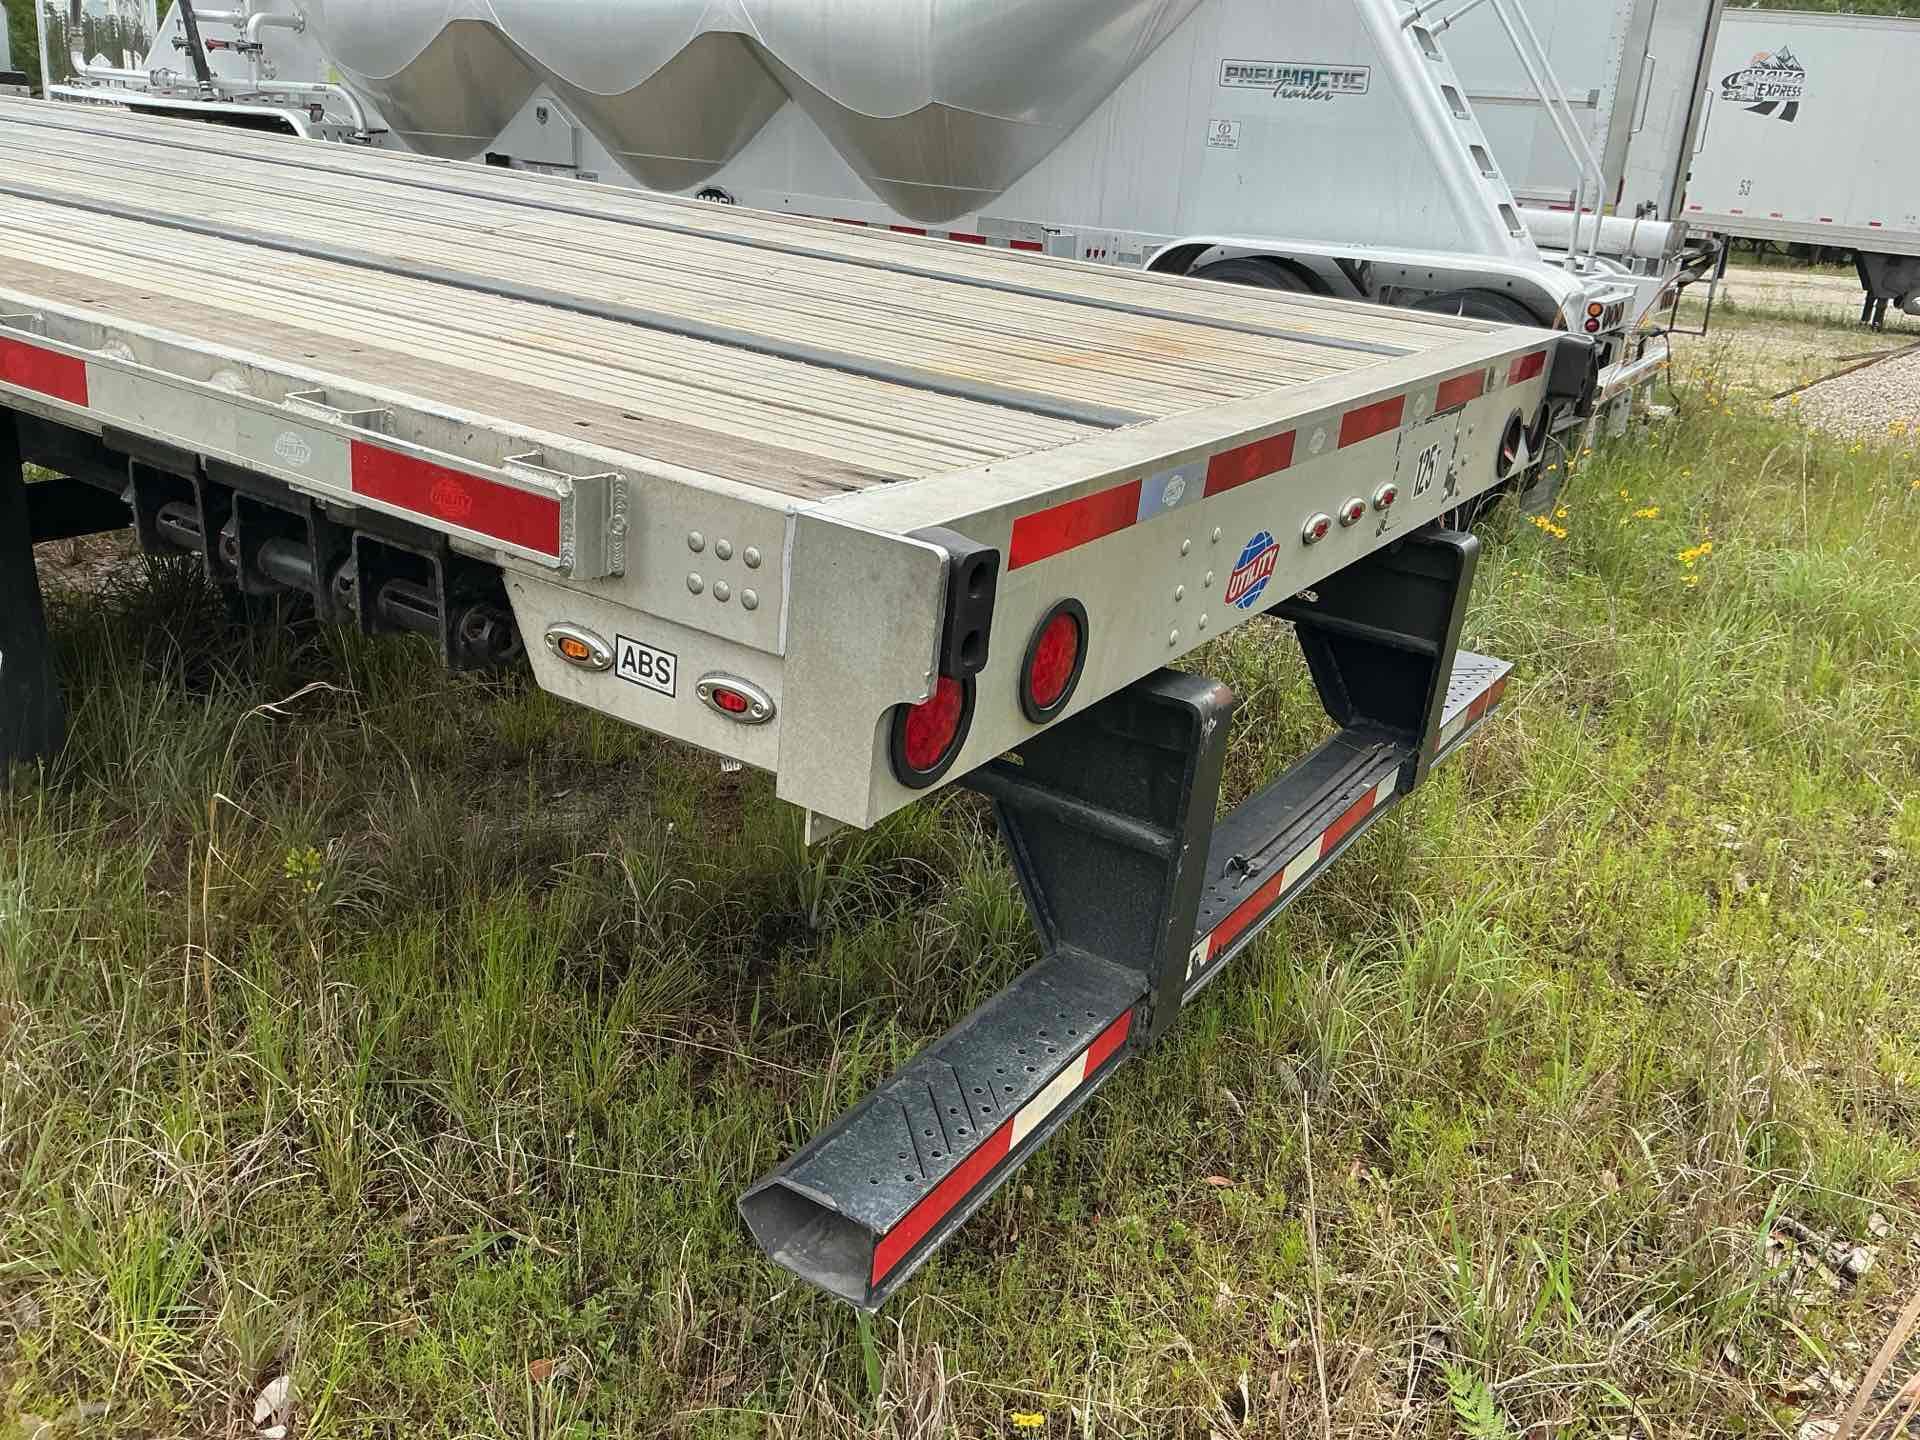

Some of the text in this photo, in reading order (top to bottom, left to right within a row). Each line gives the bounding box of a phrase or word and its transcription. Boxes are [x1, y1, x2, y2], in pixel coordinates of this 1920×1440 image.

[1271, 78, 1335, 102] Trailer
[1757, 82, 1802, 97] EXPRESS
[1227, 546, 1279, 601] UTILITY
[621, 644, 671, 685] ABS
